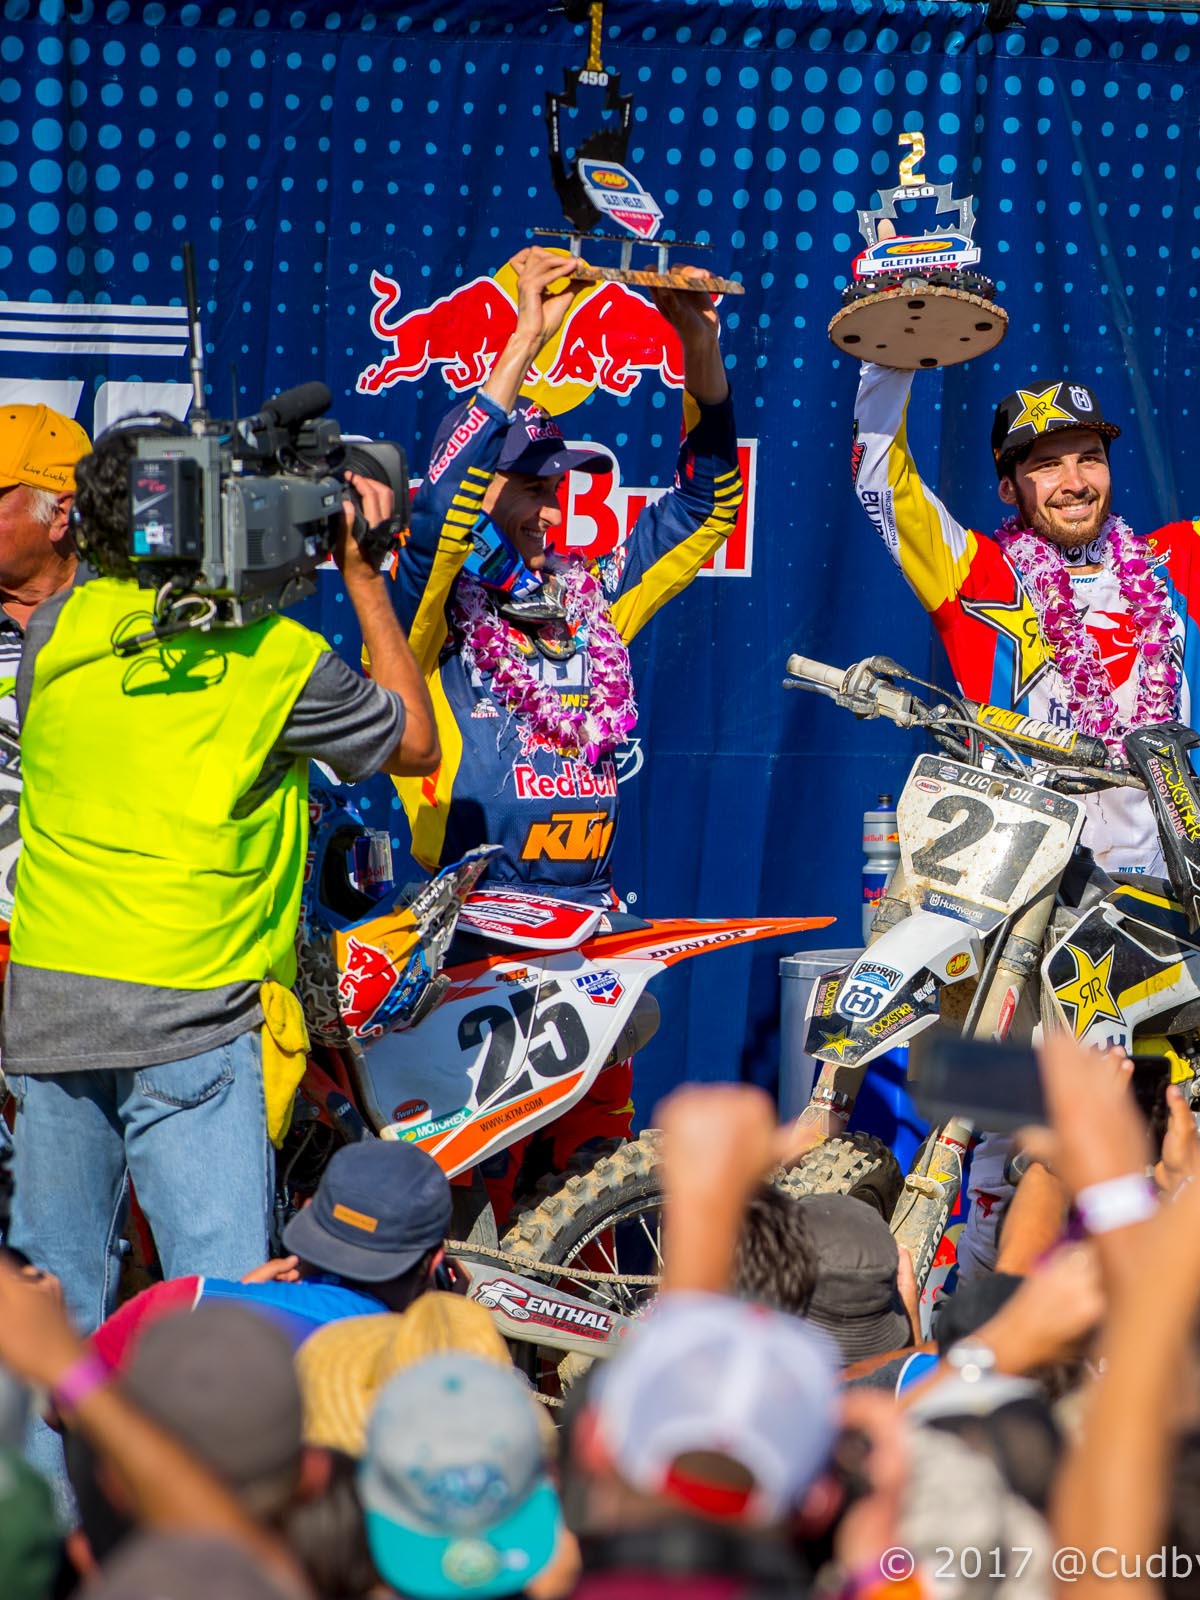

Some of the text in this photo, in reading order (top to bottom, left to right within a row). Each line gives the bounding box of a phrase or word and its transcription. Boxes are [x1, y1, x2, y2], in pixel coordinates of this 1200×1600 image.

[578, 70, 609, 87] 450
[898, 132, 926, 187] 2
[892, 186, 935, 199] 450
[882, 253, 956, 268] GLEN HELEN
[560, 693, 589, 708] ING
[982, 705, 1073, 748] PROTAPER
[1139, 735, 1165, 748] Airoh
[515, 762, 616, 798] Red Bull
[1009, 786, 1035, 805] OIL
[1147, 757, 1188, 840] ENERGY DRINK
[521, 812, 615, 861] KTM
[911, 794, 1052, 906] 21
[939, 898, 984, 919] Husqvarna
[650, 929, 746, 959] DUNLOP
[457, 980, 590, 1108] 25
[415, 1111, 468, 1140] MOTOREX
[479, 1096, 543, 1133] WWW.KTM.COM
[476, 1280, 611, 1332] RENTHAL
